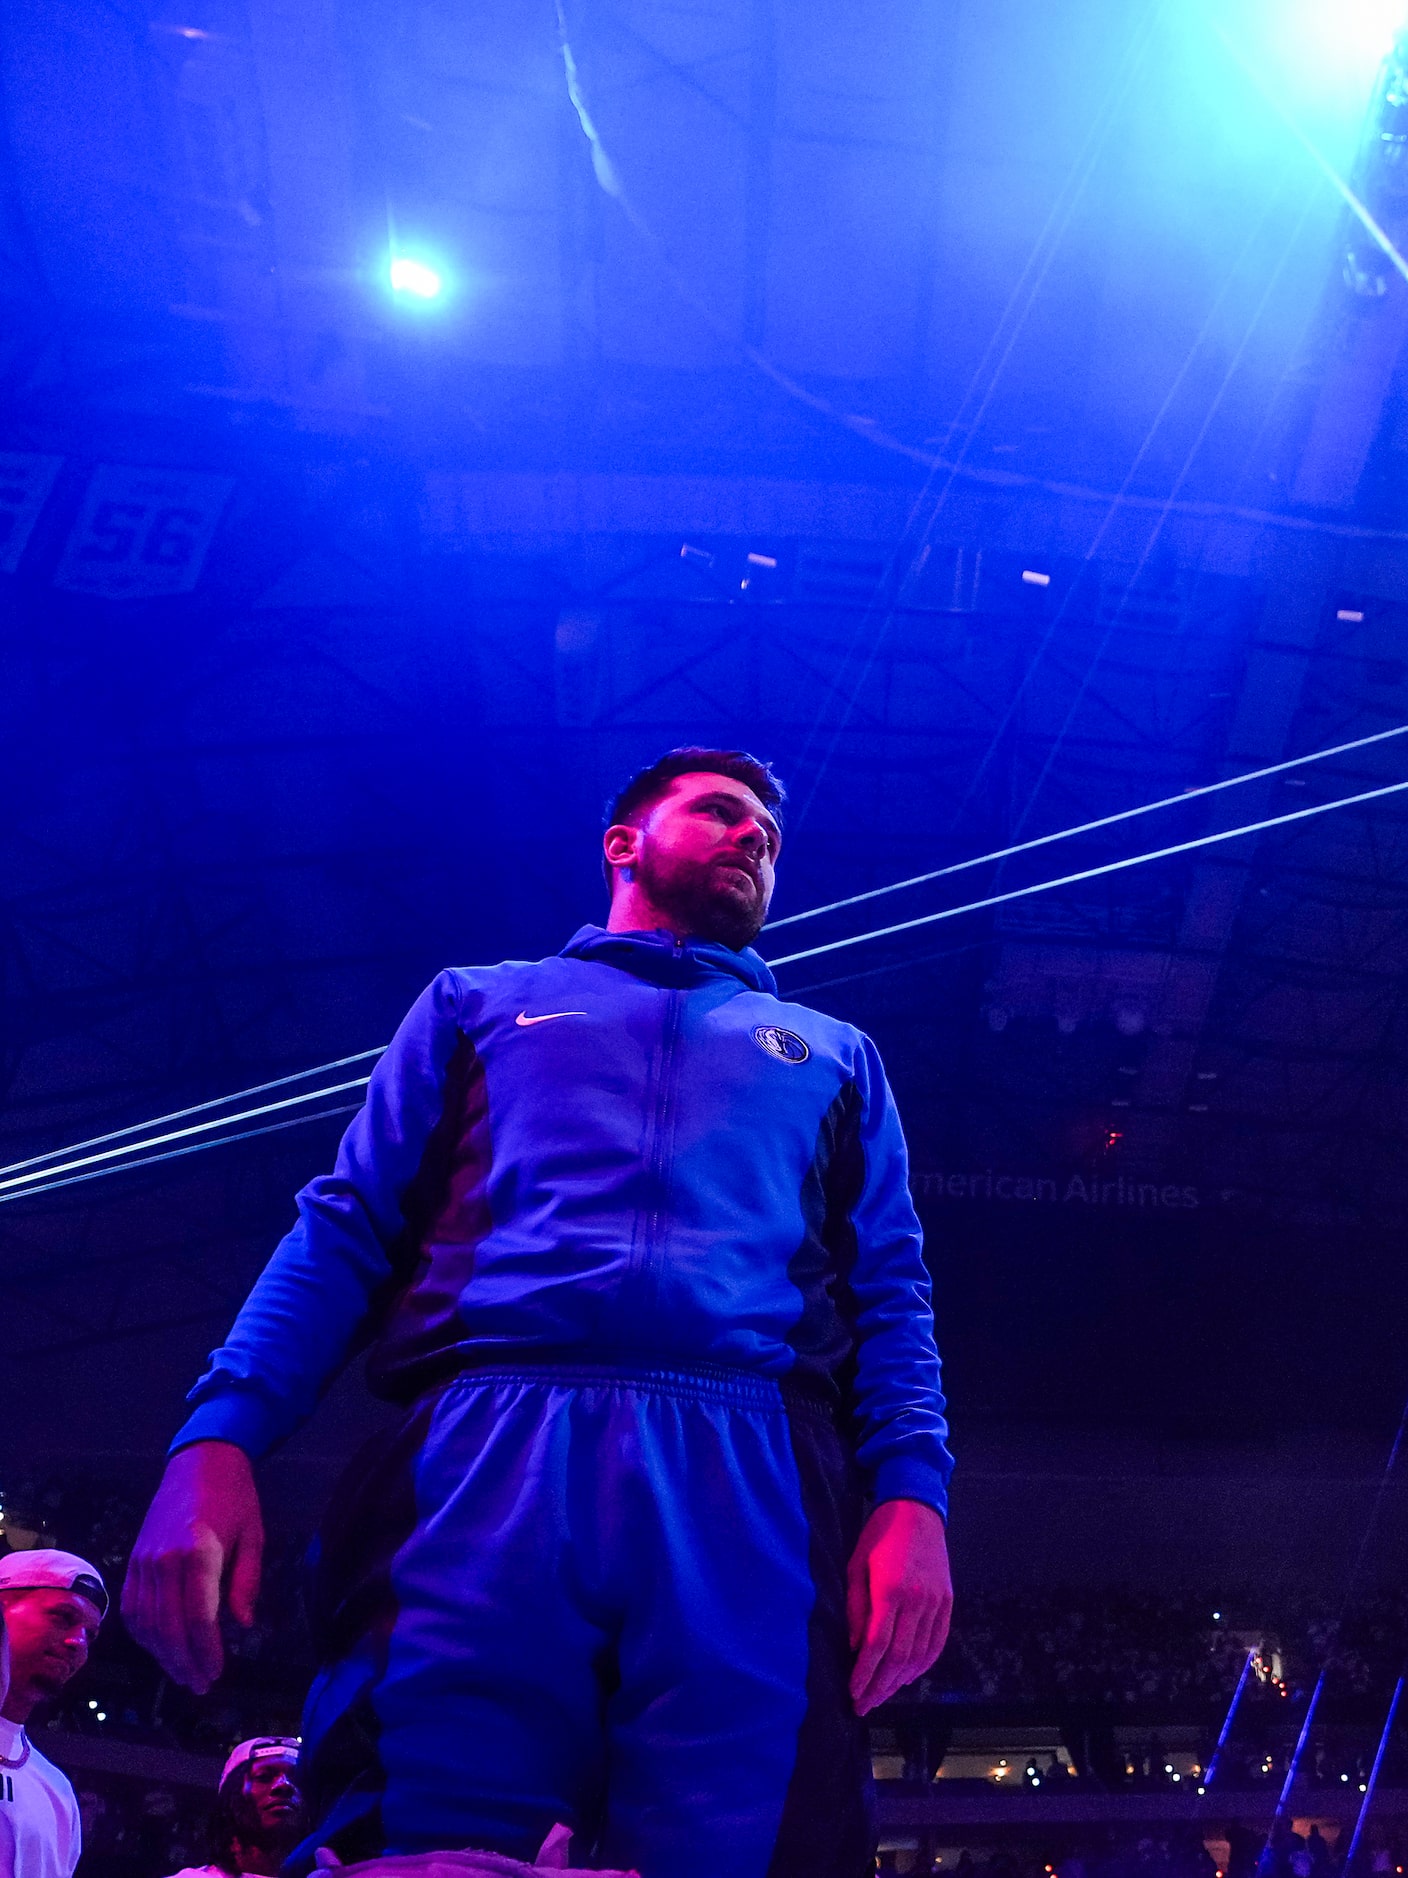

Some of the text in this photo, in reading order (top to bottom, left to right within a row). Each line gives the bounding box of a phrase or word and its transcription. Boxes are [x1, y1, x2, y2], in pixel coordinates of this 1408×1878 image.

[77, 500, 205, 567] 56
[912, 1169, 1200, 1209] merican Airlines
